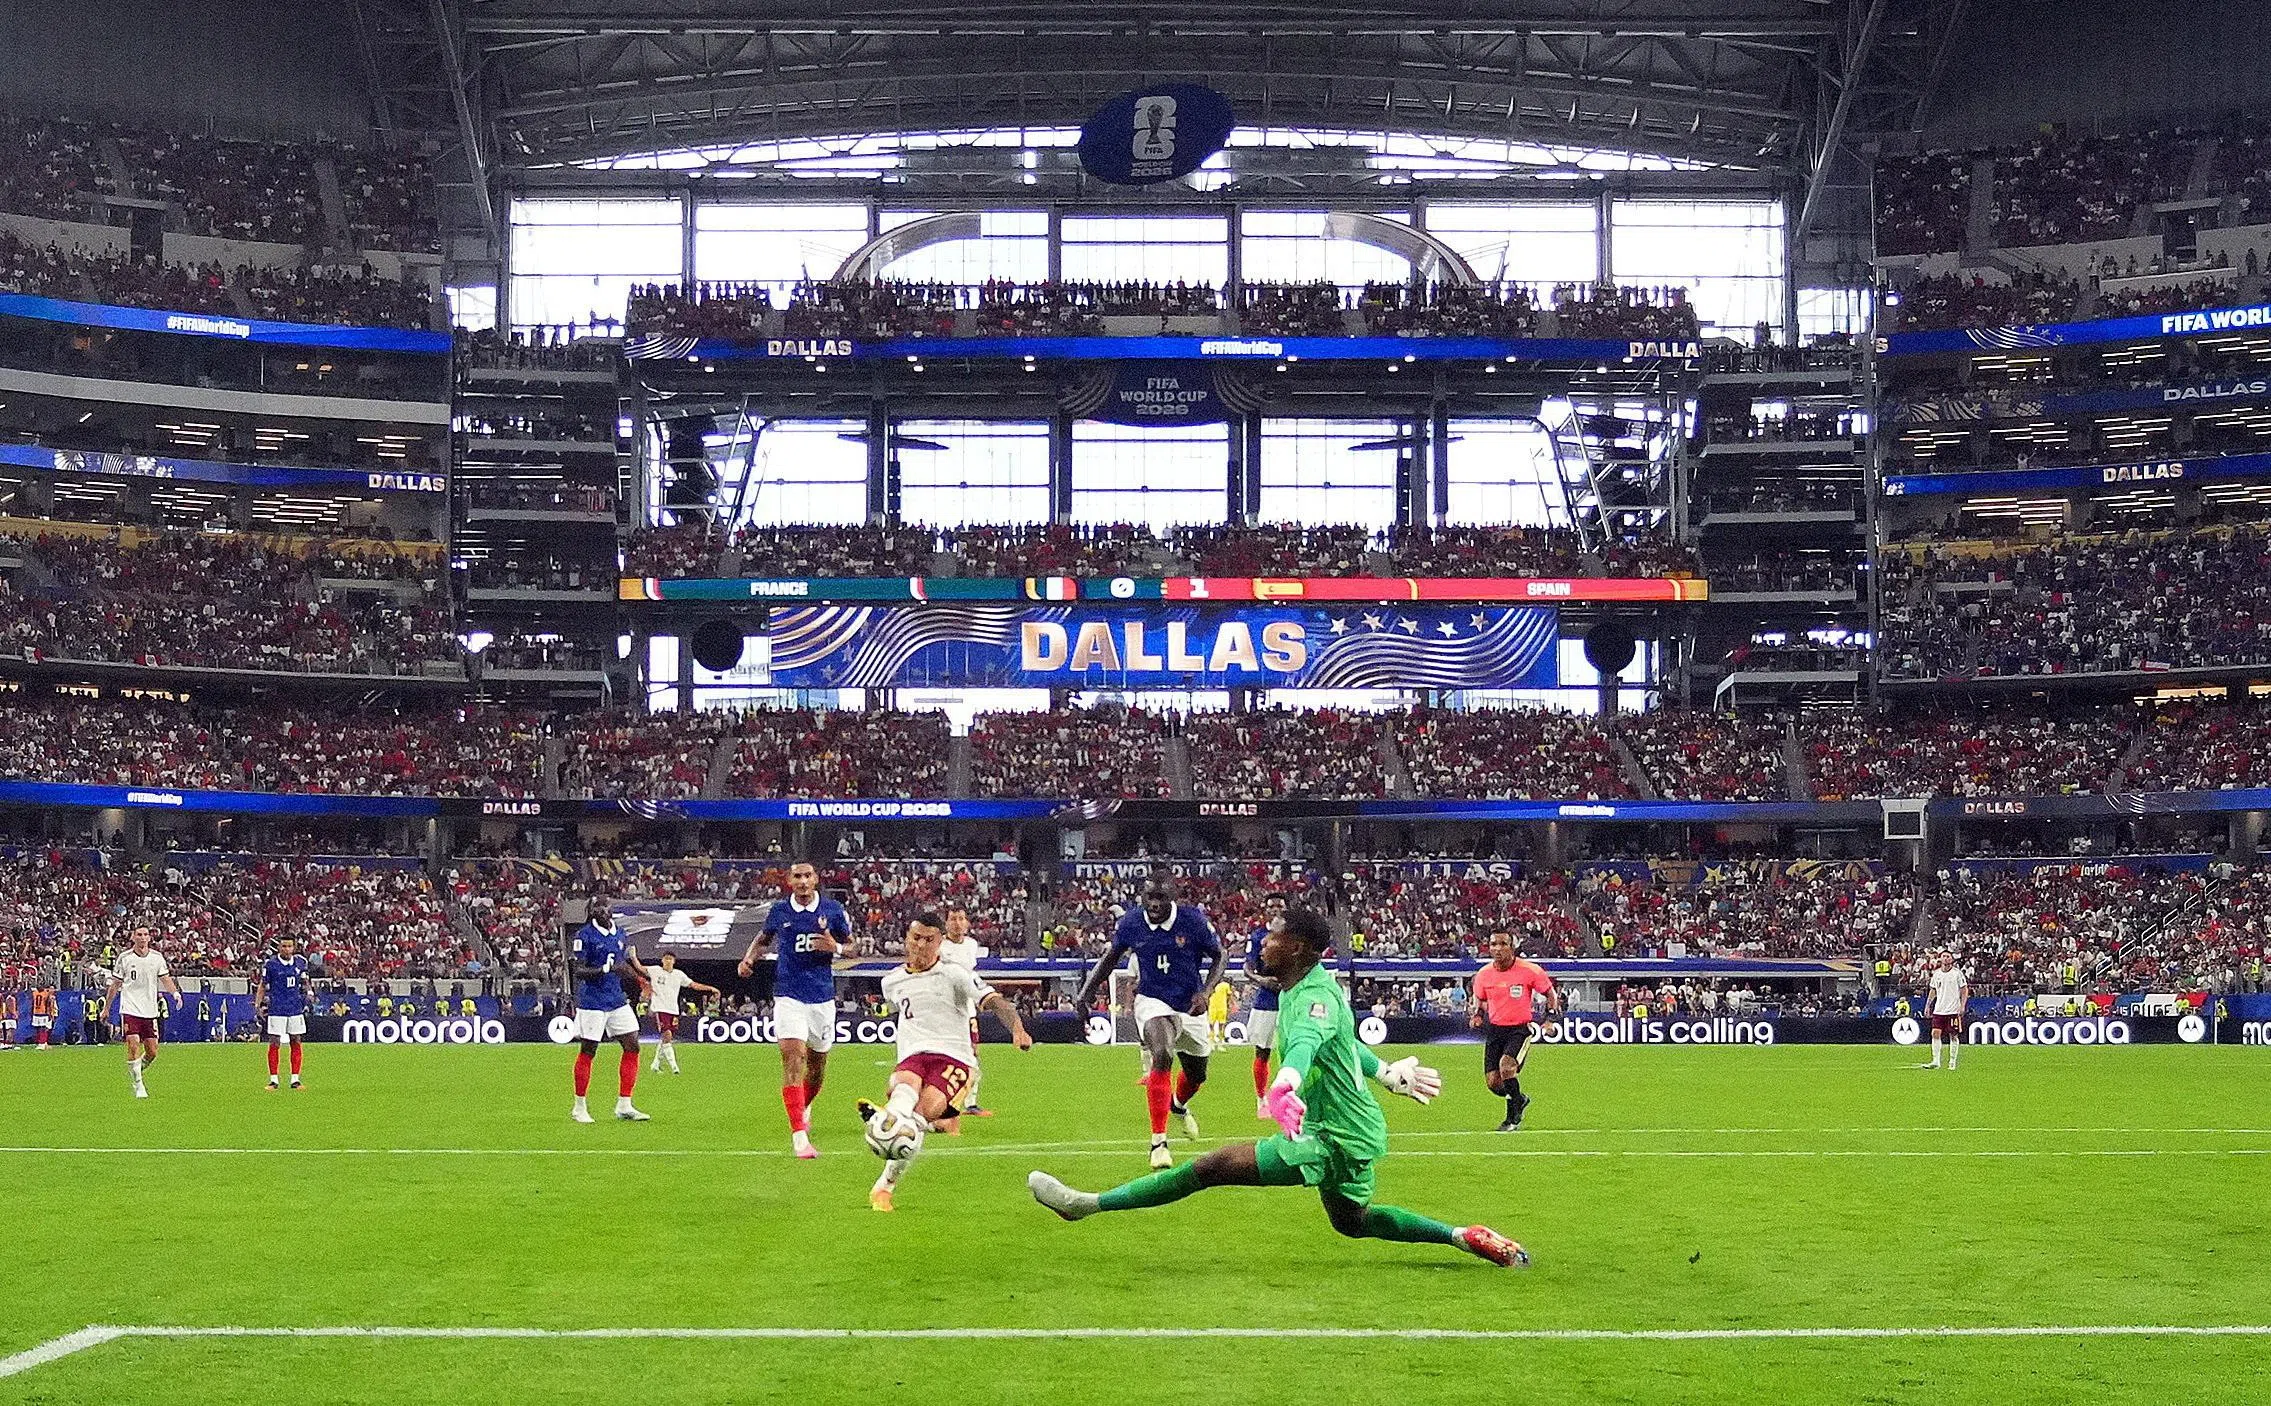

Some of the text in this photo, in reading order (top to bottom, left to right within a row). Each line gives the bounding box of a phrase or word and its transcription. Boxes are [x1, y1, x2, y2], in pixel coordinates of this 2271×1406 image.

[167, 316, 250, 338] #FIFAWorldCup
[2162, 307, 2271, 334] FIFA WORL
[768, 340, 852, 357] DALLAS
[1201, 341, 1283, 357] #FIFAWorldCup
[1629, 342, 1701, 358] DALLA
[1147, 378, 1180, 390] FIFA
[2164, 381, 2267, 402] DALLAS
[1120, 391, 1208, 403] WORLD CUP
[1136, 404, 1189, 416] 2026
[2103, 463, 2184, 482] DALLAS
[369, 473, 445, 492] DALLAS
[751, 581, 808, 597] FRANCE
[1190, 579, 1209, 598] 1
[1526, 581, 1571, 596] SPAIN
[1020, 621, 1306, 672] DALLAS
[483, 803, 541, 815] DALLAS
[789, 803, 952, 816] FIFA WORLD CUP 2026
[1200, 804, 1258, 816] DALLAS
[1157, 954, 1171, 975] 4
[286, 976, 296, 988] 10
[343, 1017, 505, 1044] motorola
[1641, 1017, 1664, 1043] is
[1669, 1017, 1774, 1046] calling
[1968, 1018, 2130, 1045] motorola
